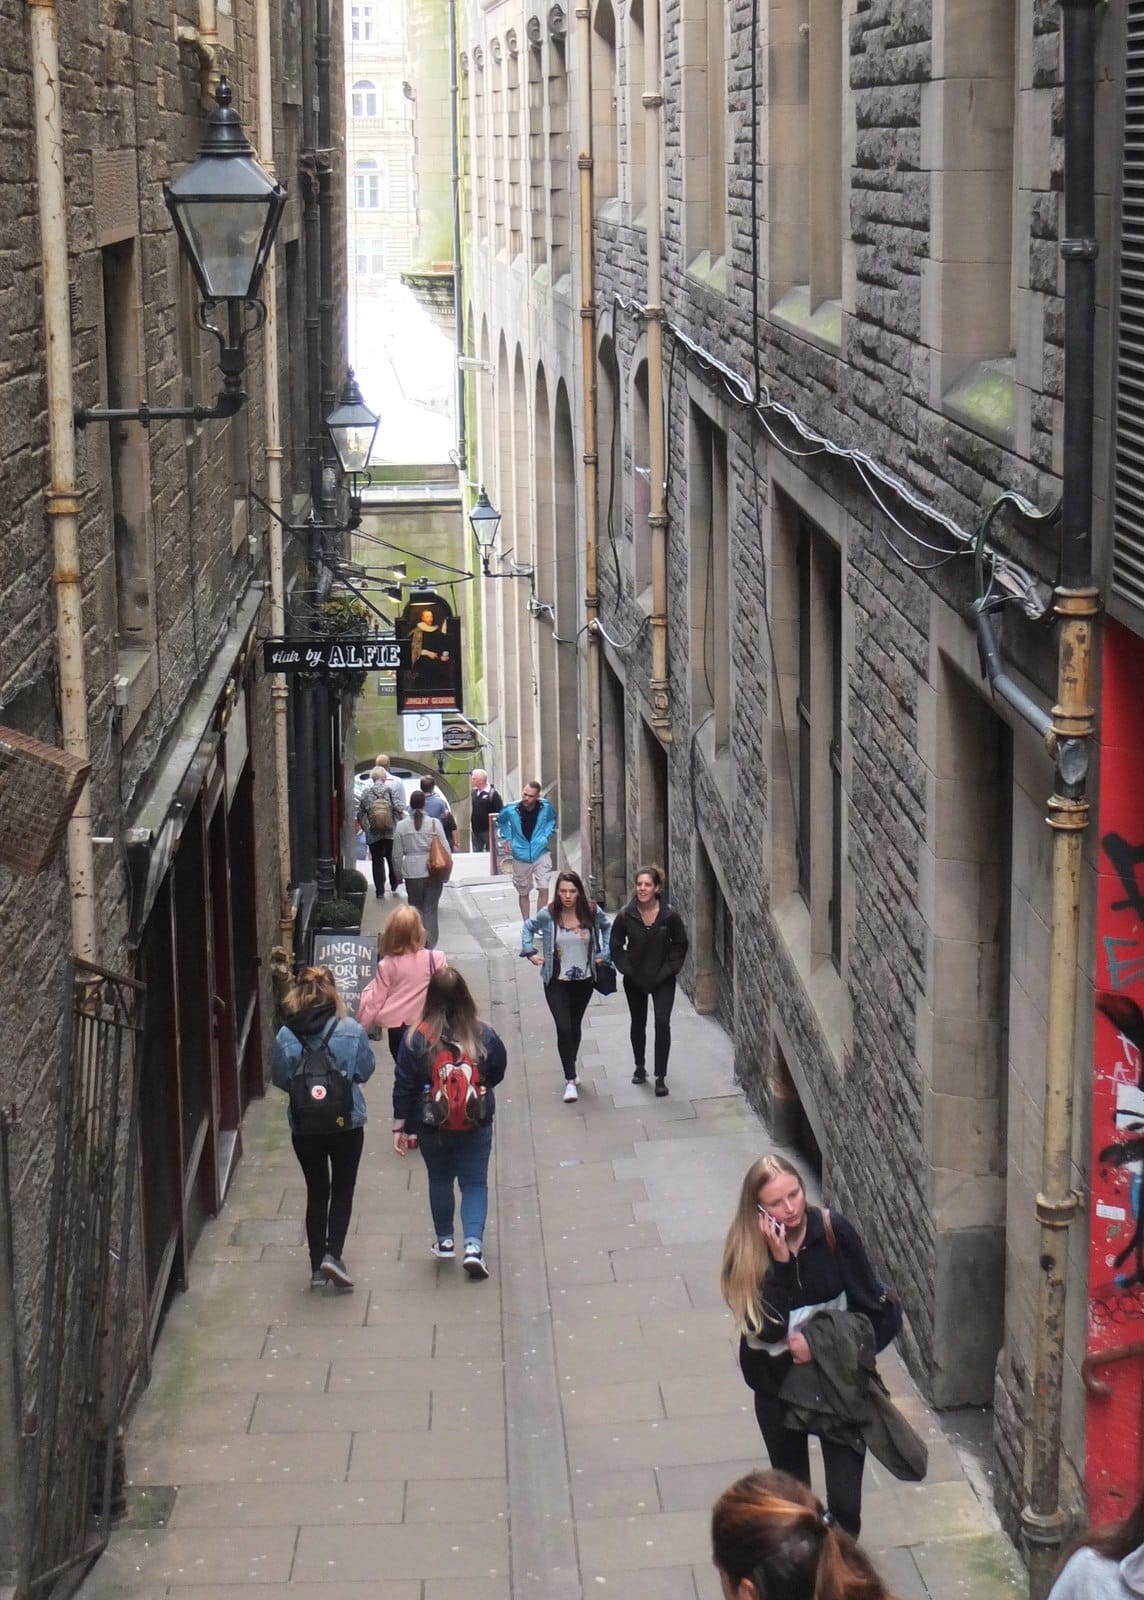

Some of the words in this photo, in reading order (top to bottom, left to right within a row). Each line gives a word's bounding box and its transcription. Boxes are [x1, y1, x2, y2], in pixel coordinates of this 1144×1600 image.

[272, 649, 301, 664] Hair
[305, 648, 325, 667] by
[328, 645, 401, 668] ALFIE
